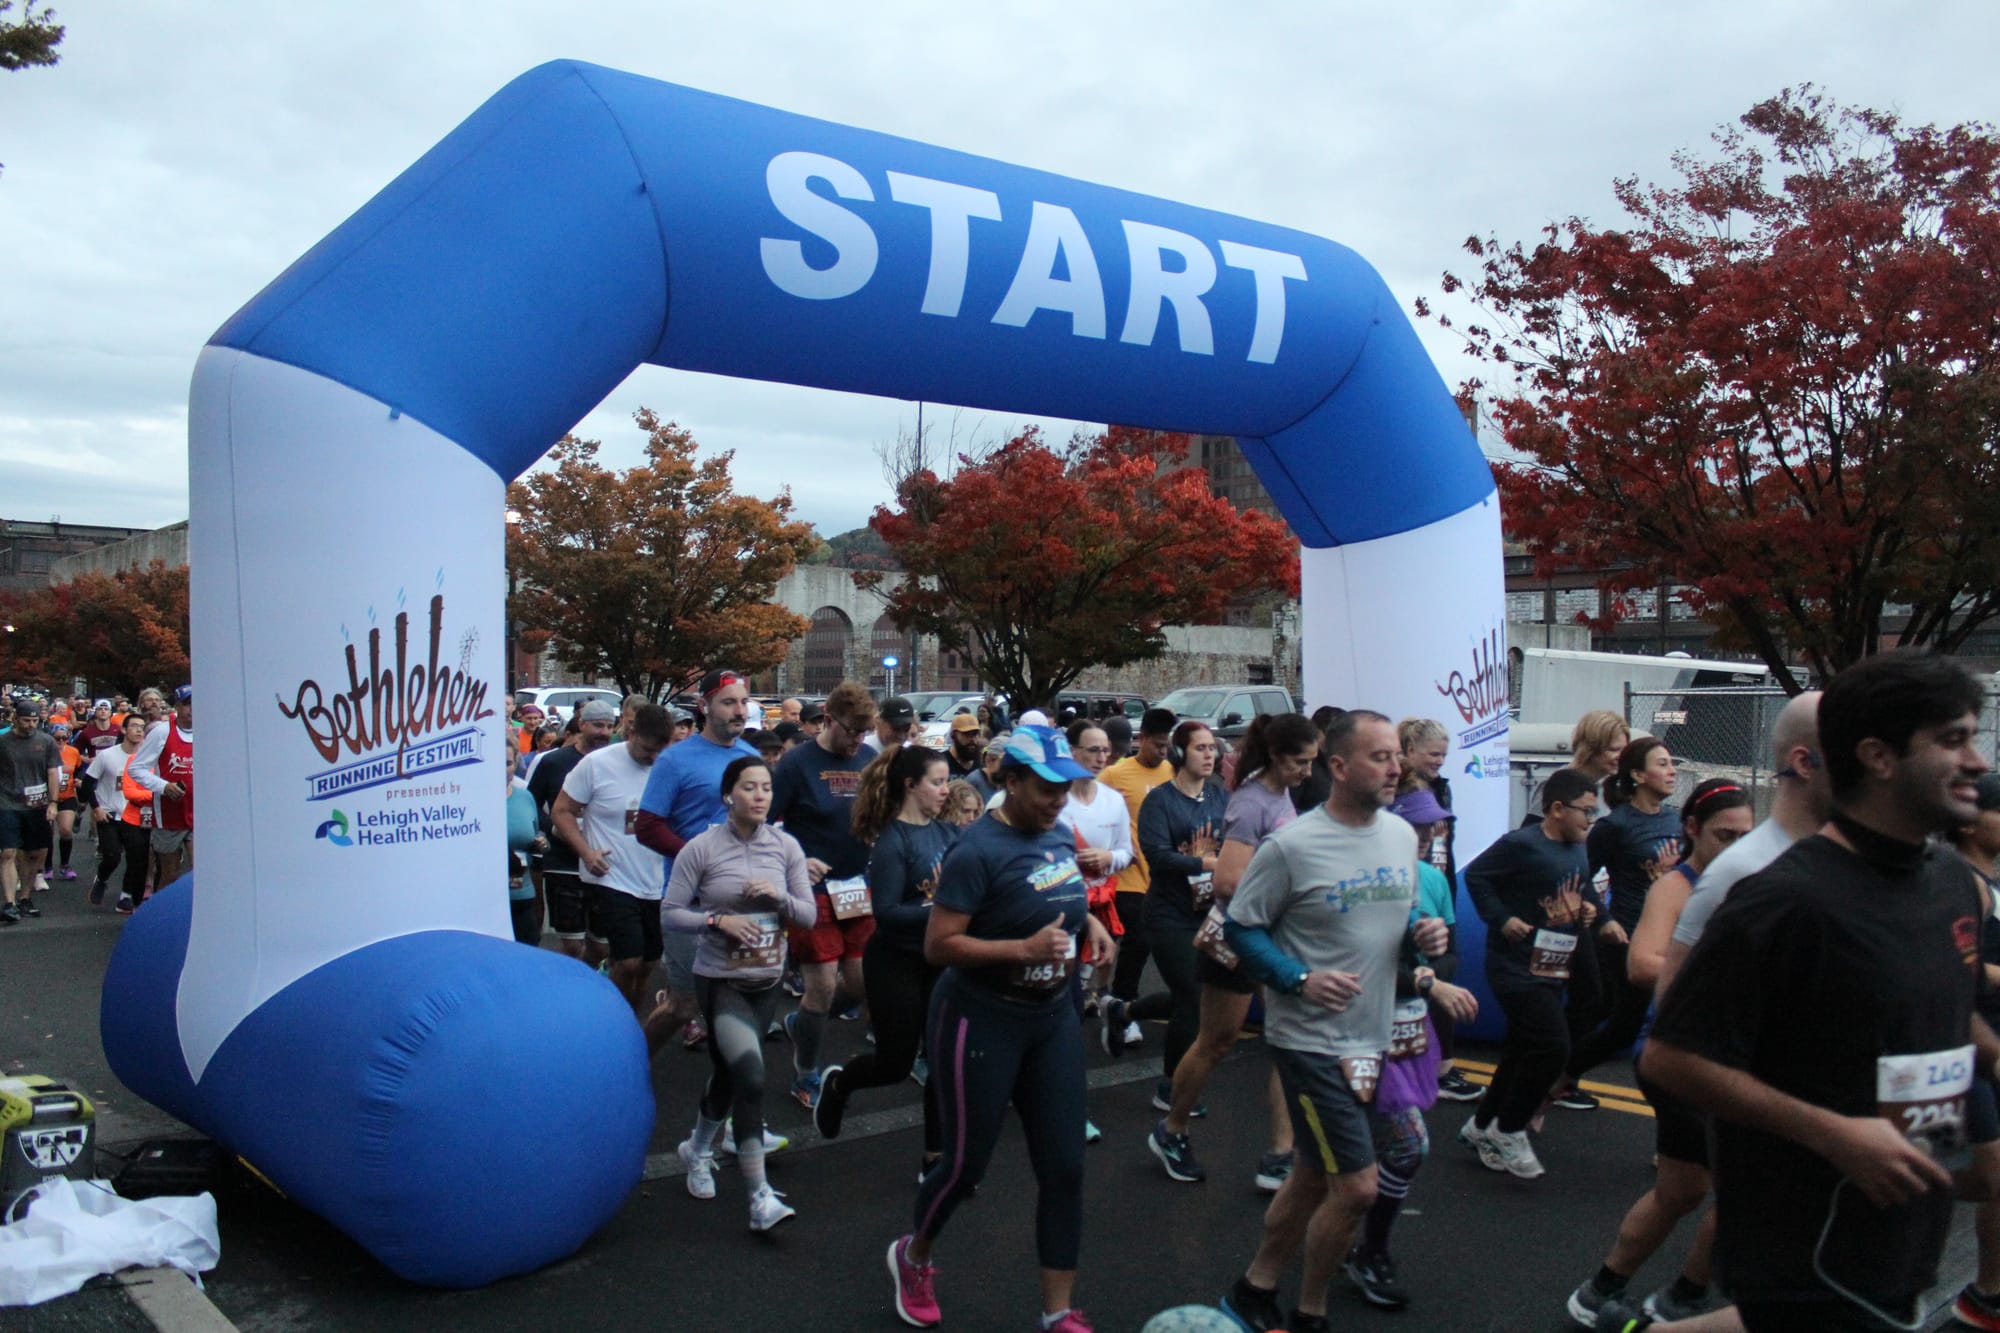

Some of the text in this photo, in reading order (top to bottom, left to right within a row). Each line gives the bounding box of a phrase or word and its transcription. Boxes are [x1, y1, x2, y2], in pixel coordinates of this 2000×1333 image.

[760, 151, 1308, 364] START
[277, 594, 497, 779] Bethlehem
[316, 736, 475, 793] RUNNING FESTIVAL
[386, 783, 461, 801] presented by
[356, 805, 466, 829] Lehigh Valley
[357, 818, 482, 846] Health Network
[837, 891, 865, 904] 2077
